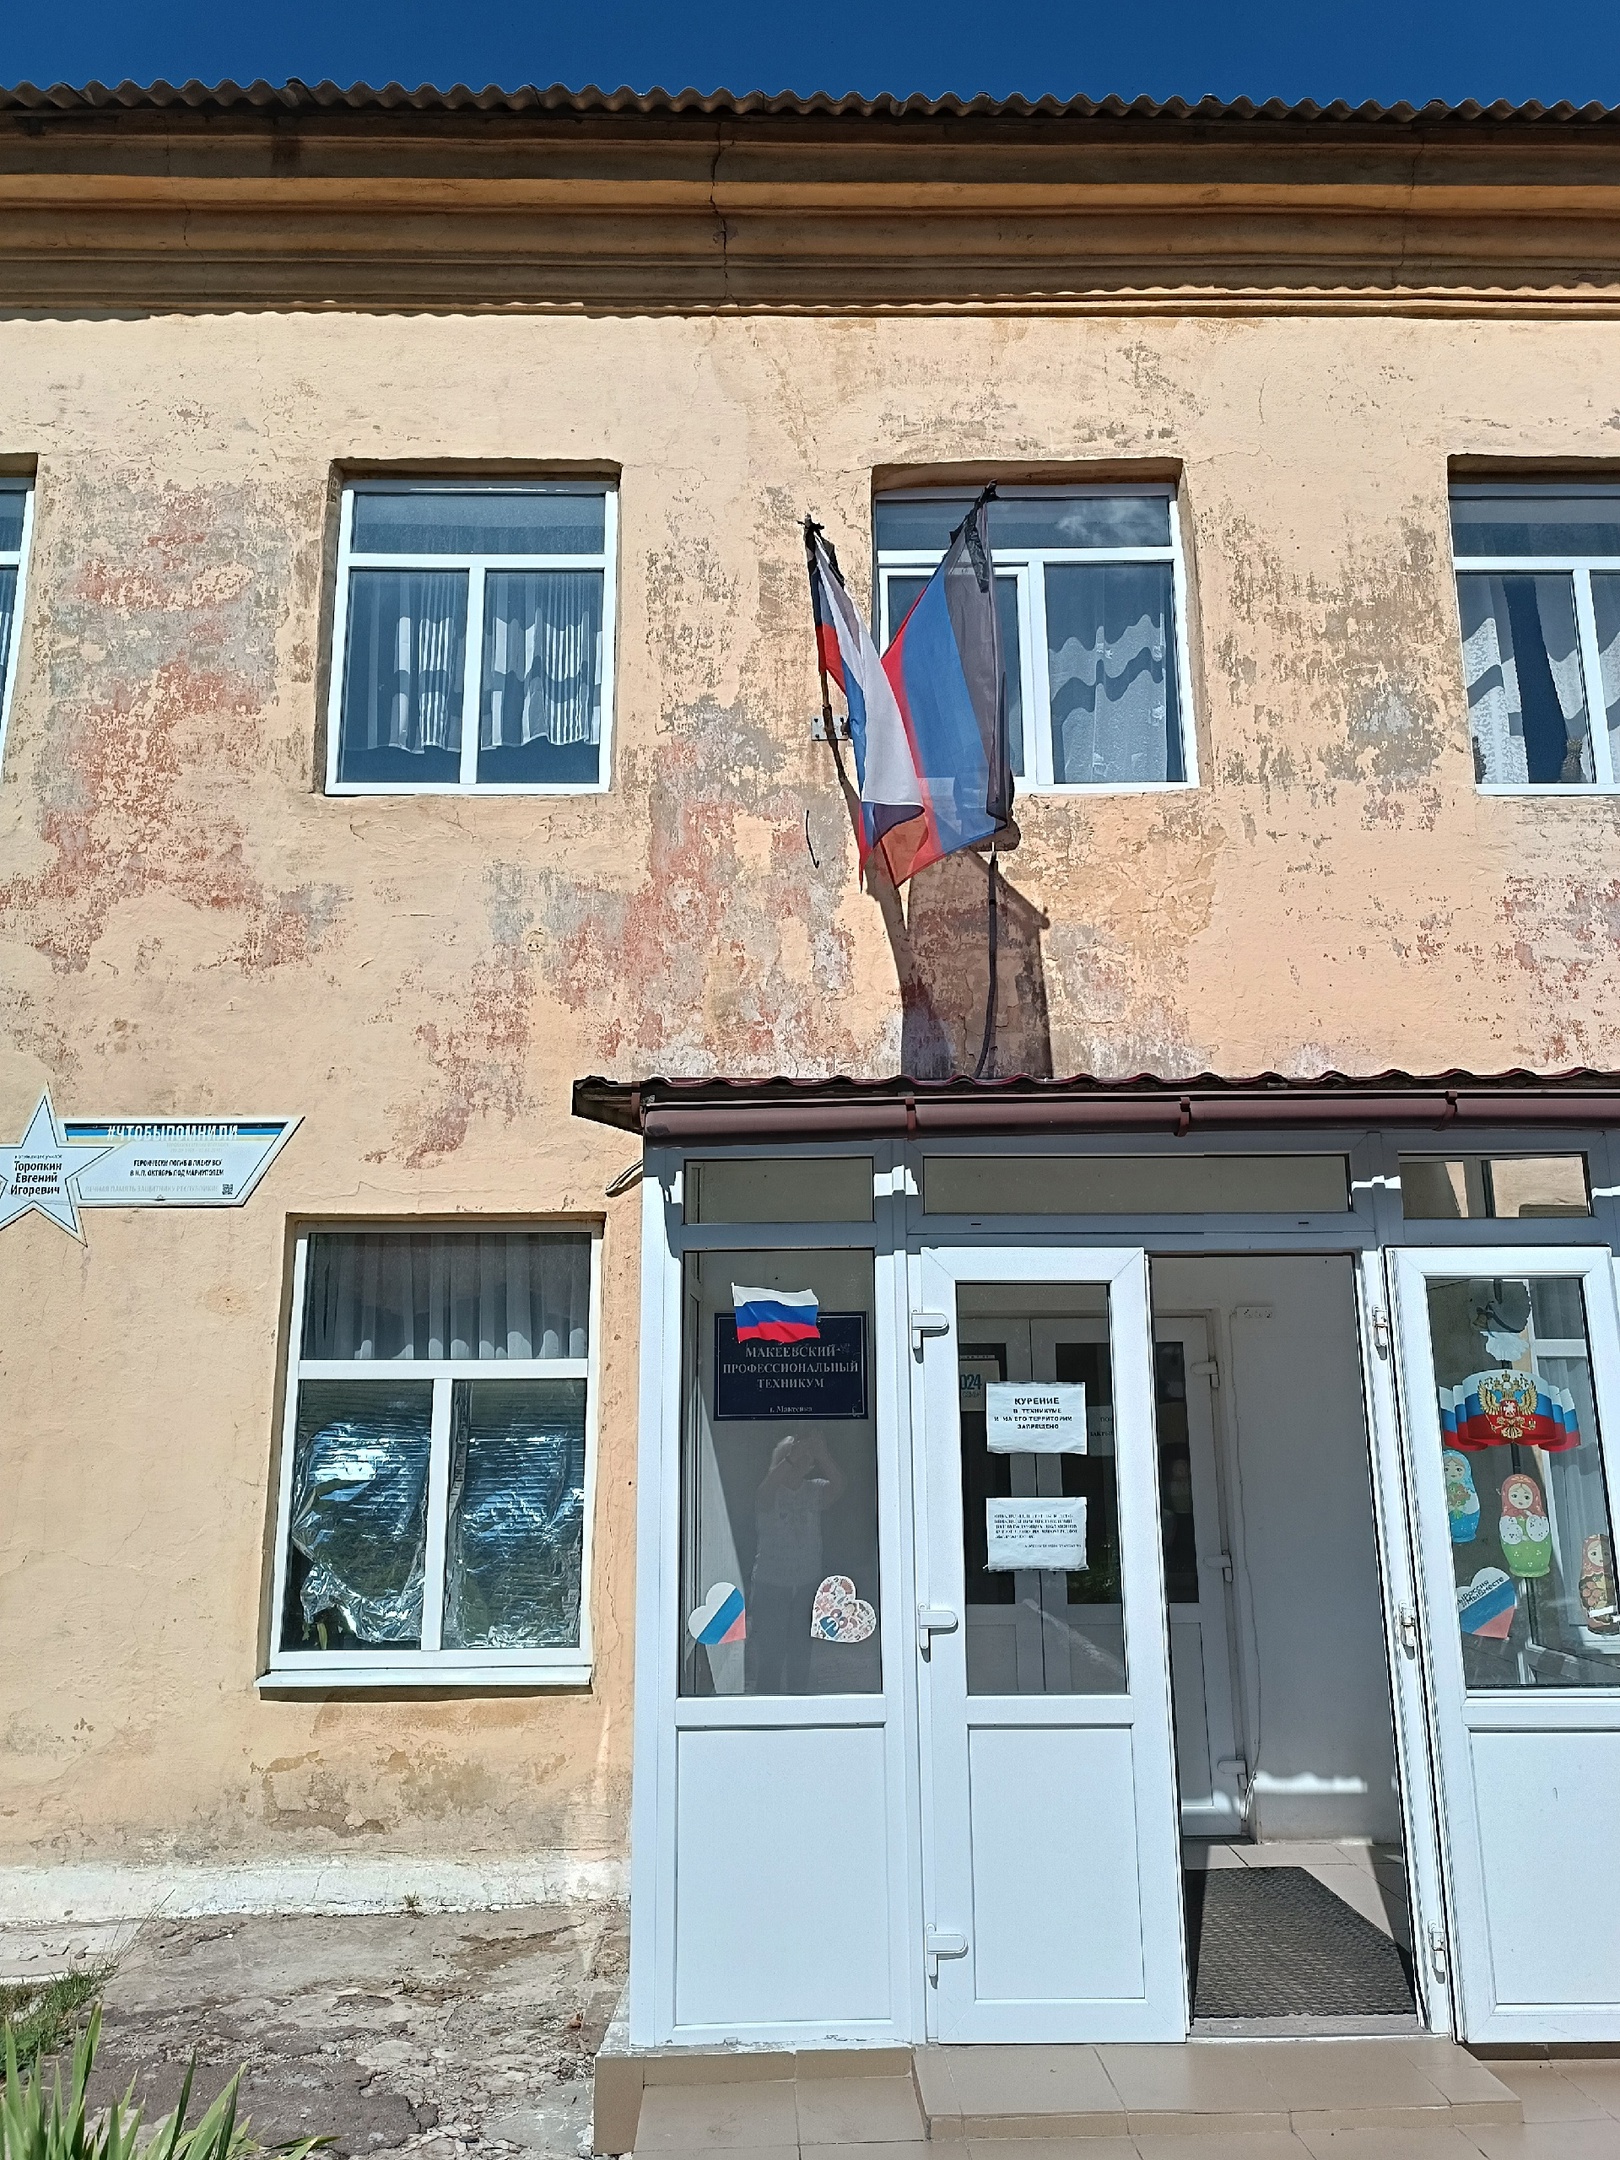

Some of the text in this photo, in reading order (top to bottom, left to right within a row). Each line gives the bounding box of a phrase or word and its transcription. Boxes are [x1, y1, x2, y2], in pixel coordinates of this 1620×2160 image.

[107, 1125, 238, 1141] #ЧТОБЫПОМНИЛИ
[14, 1161, 62, 1173] Торопкин
[16, 1172, 58, 1183] Евгений
[11, 1185, 60, 1197] Игоревич
[745, 1344, 836, 1358] МАКЕЕВСКИЙ
[723, 1360, 858, 1374] ПРОФЕССИОНАЛЬНЫЙ
[757, 1378, 824, 1389] ТЕХНИКУМ
[1014, 1397, 1060, 1405] КУРЕНИЕ
